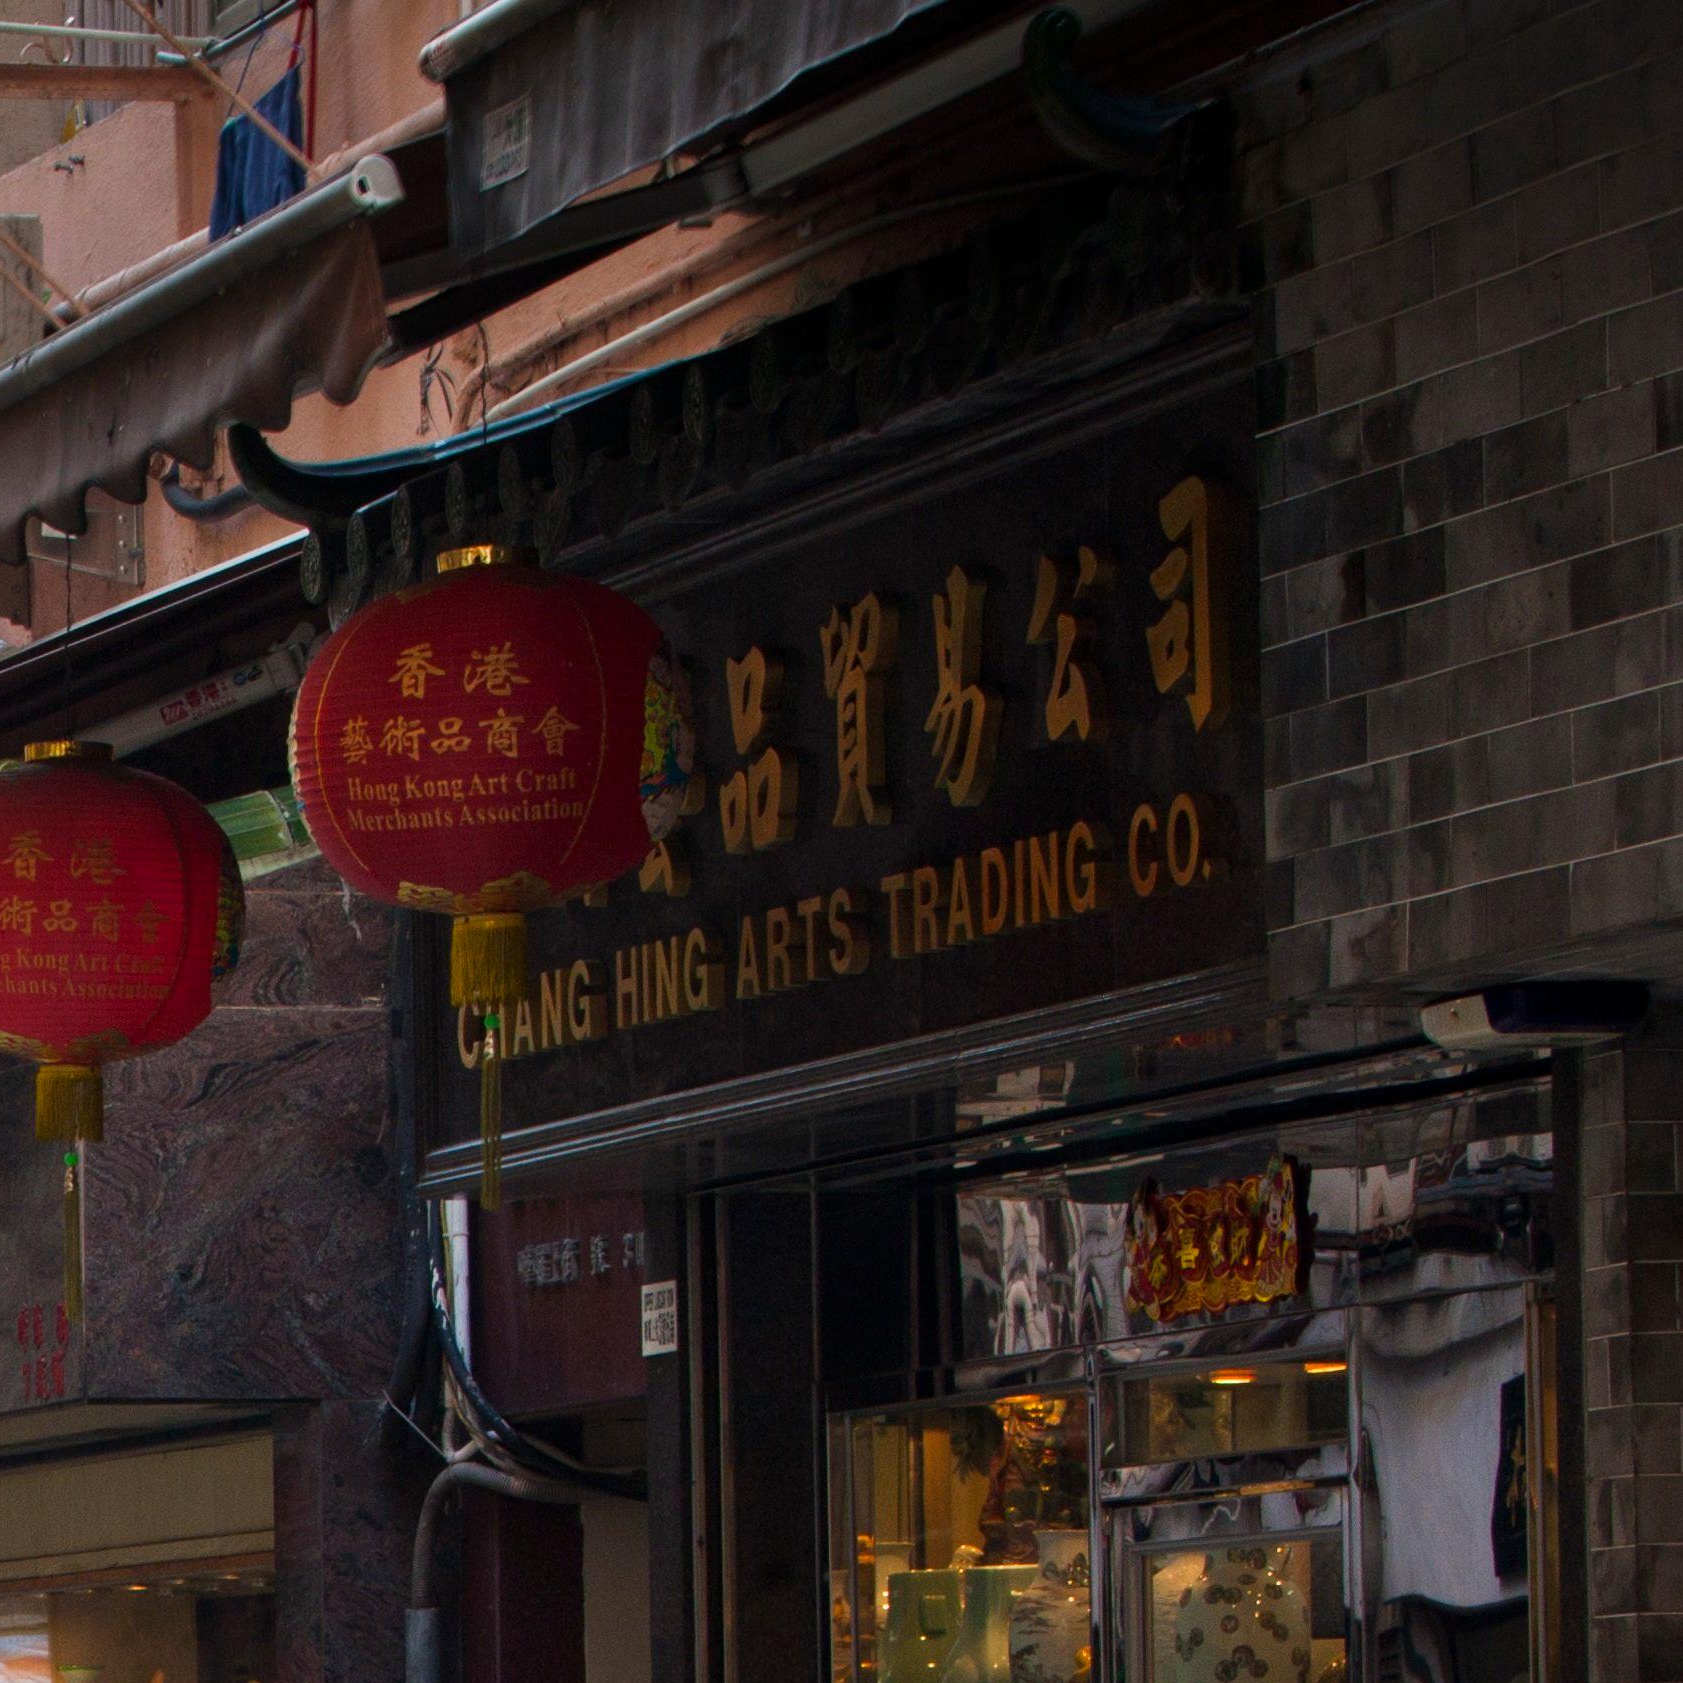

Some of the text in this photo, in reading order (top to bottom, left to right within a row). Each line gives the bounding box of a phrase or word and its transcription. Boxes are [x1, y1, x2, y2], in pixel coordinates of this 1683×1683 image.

[388, 642, 530, 699] 香港
[640, 475, 1216, 895] 品貿易公司
[340, 706, 581, 764] 藝術品商會
[347, 766, 578, 806] Hong Kong Art Craft
[346, 797, 585, 832] Merchants Association
[2, 830, 129, 885] 香港
[616, 927, 710, 1029] HING
[737, 889, 856, 999] ARTS
[881, 820, 1098, 961] TRADING
[1128, 793, 1214, 898] CO.
[17, 948, 69, 976] Kong
[74, 952, 109, 972] Art
[114, 954, 165, 974] Craft
[64, 975, 171, 999] Association
